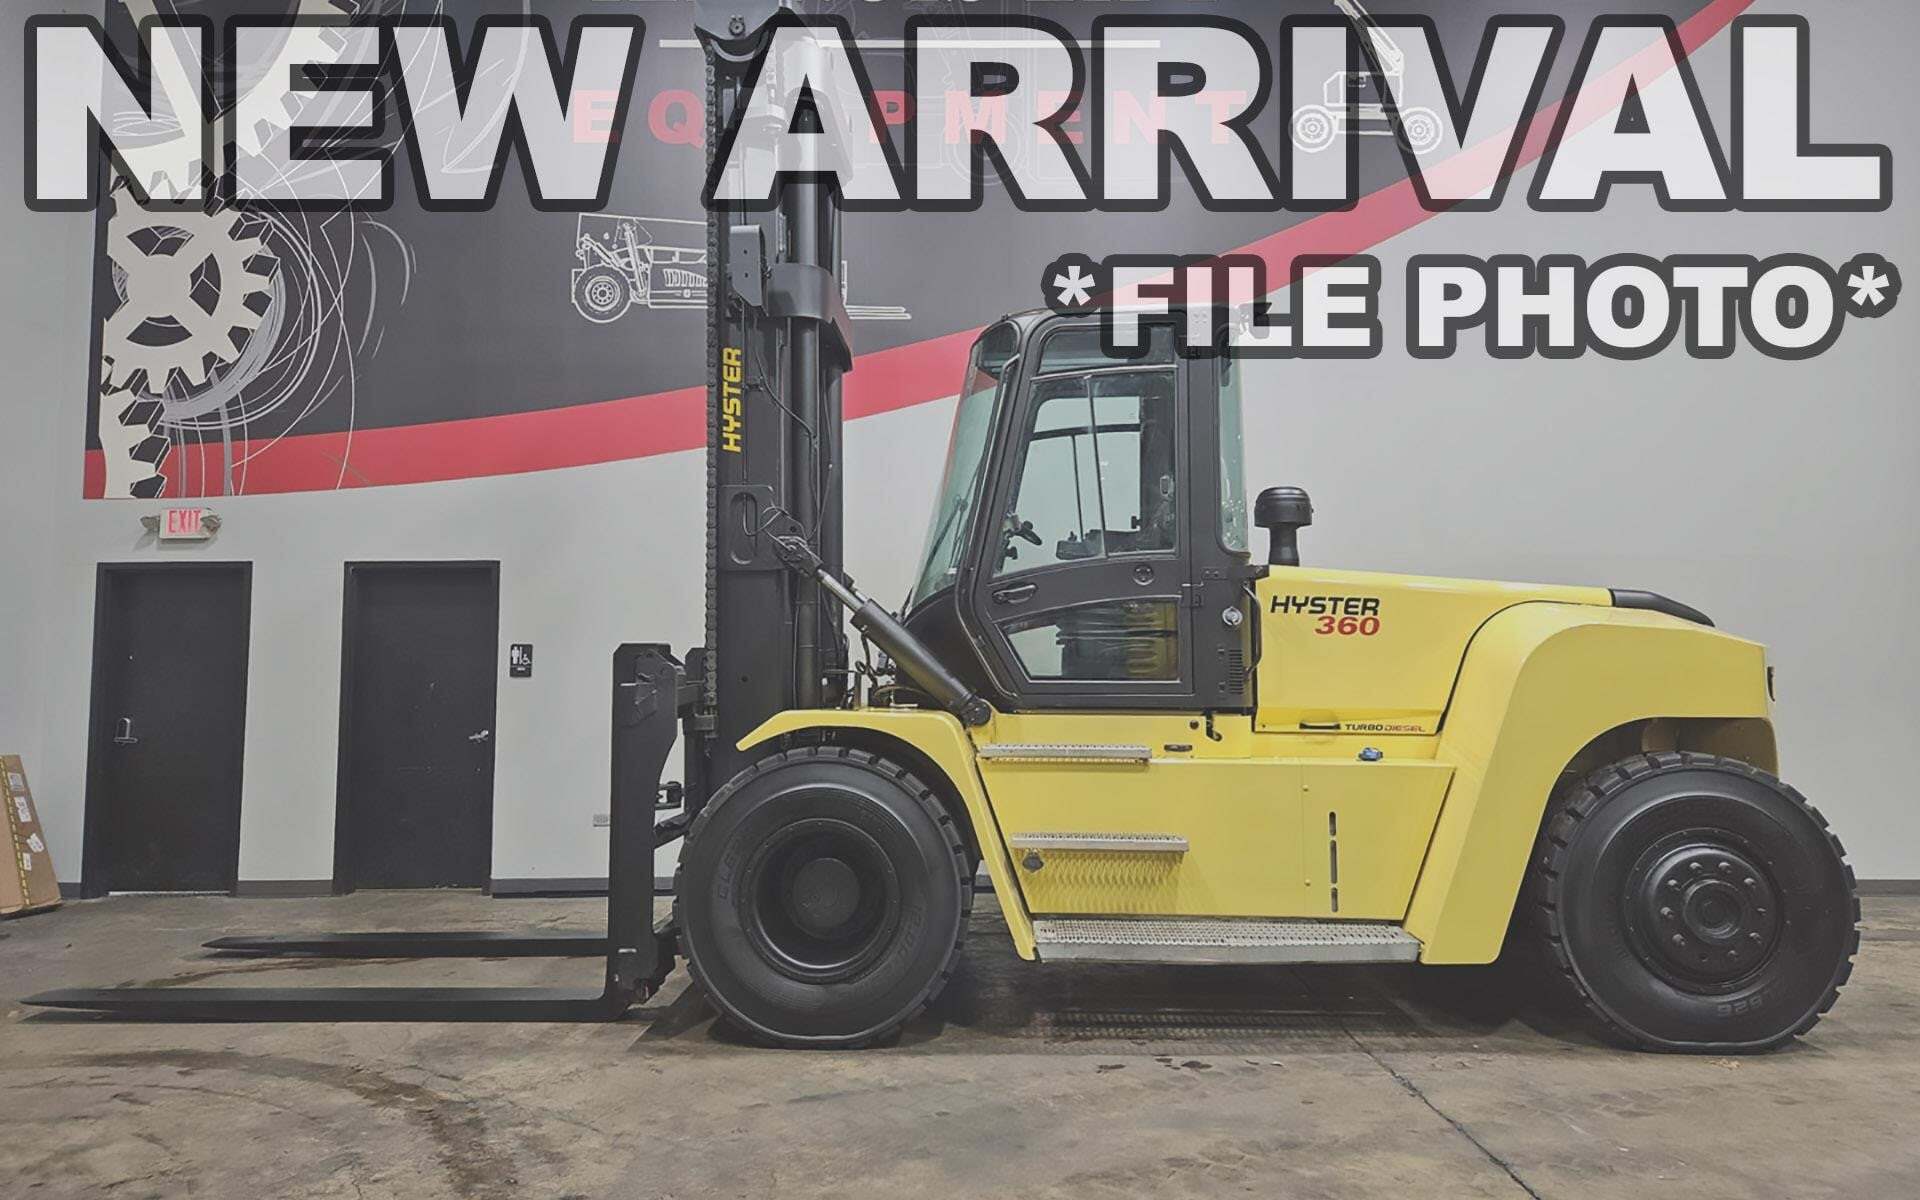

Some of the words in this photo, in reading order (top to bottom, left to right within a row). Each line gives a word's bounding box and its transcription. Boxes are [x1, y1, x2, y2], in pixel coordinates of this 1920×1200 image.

[571, 90, 1248, 149] EQPMENT
[722, 347, 742, 453] HYSTER
[168, 509, 202, 534] EXIT
[1270, 595, 1381, 616] HYSTER
[1314, 615, 1381, 636] 360
